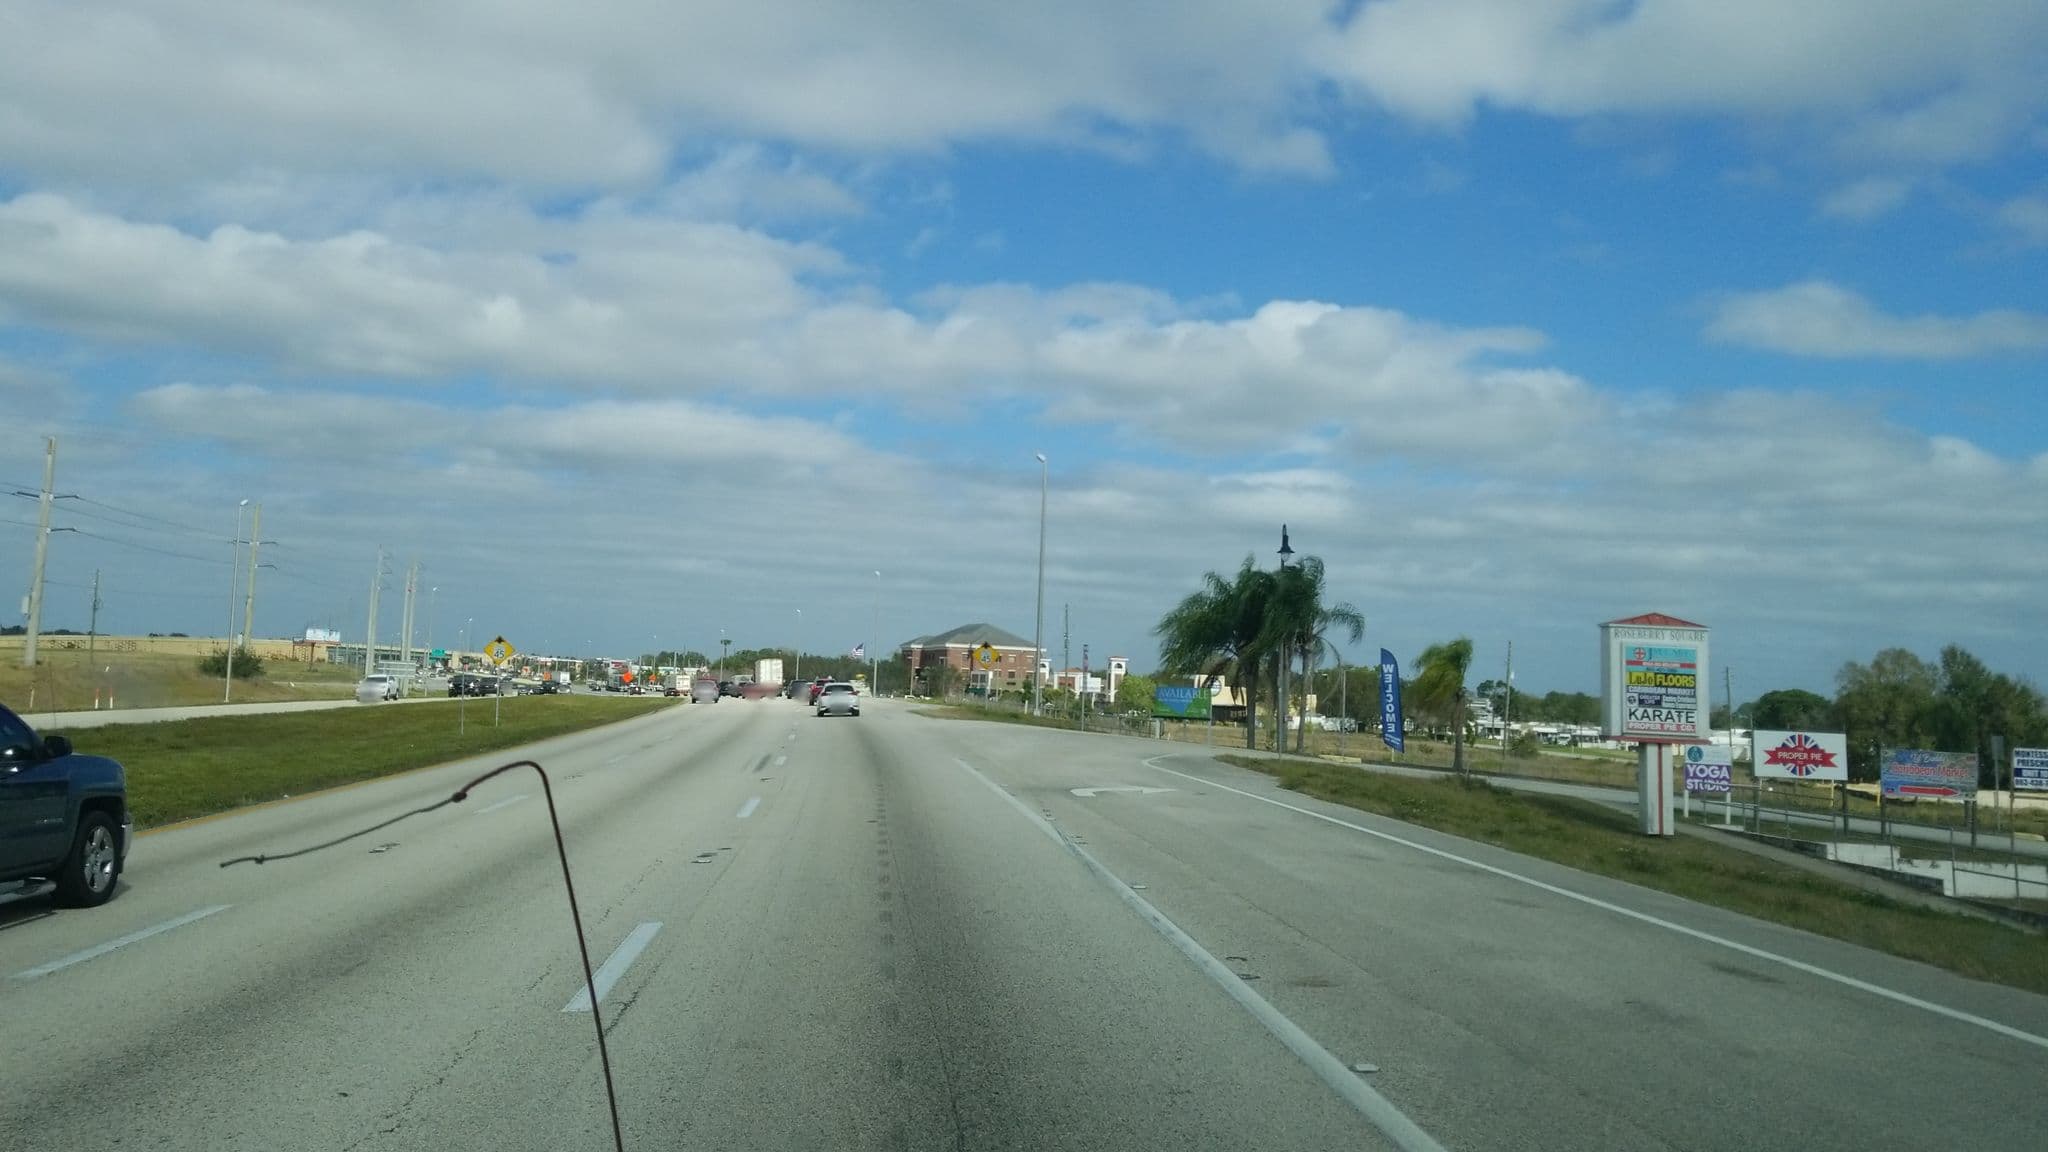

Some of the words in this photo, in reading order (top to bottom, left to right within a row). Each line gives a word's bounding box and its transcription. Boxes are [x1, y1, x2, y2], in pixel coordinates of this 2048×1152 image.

[1671, 631, 1705, 641] SQUARE
[494, 650, 505, 658] 45
[1656, 674, 1695, 687] FLOORS
[1158, 688, 1209, 699] AVAILABLE
[1629, 708, 1695, 724] KARATE
[1778, 751, 1808, 761] PROPER
[1810, 752, 1824, 761] PIE
[1686, 764, 1730, 780] YOGA
[1686, 777, 1730, 792] STUDIO
